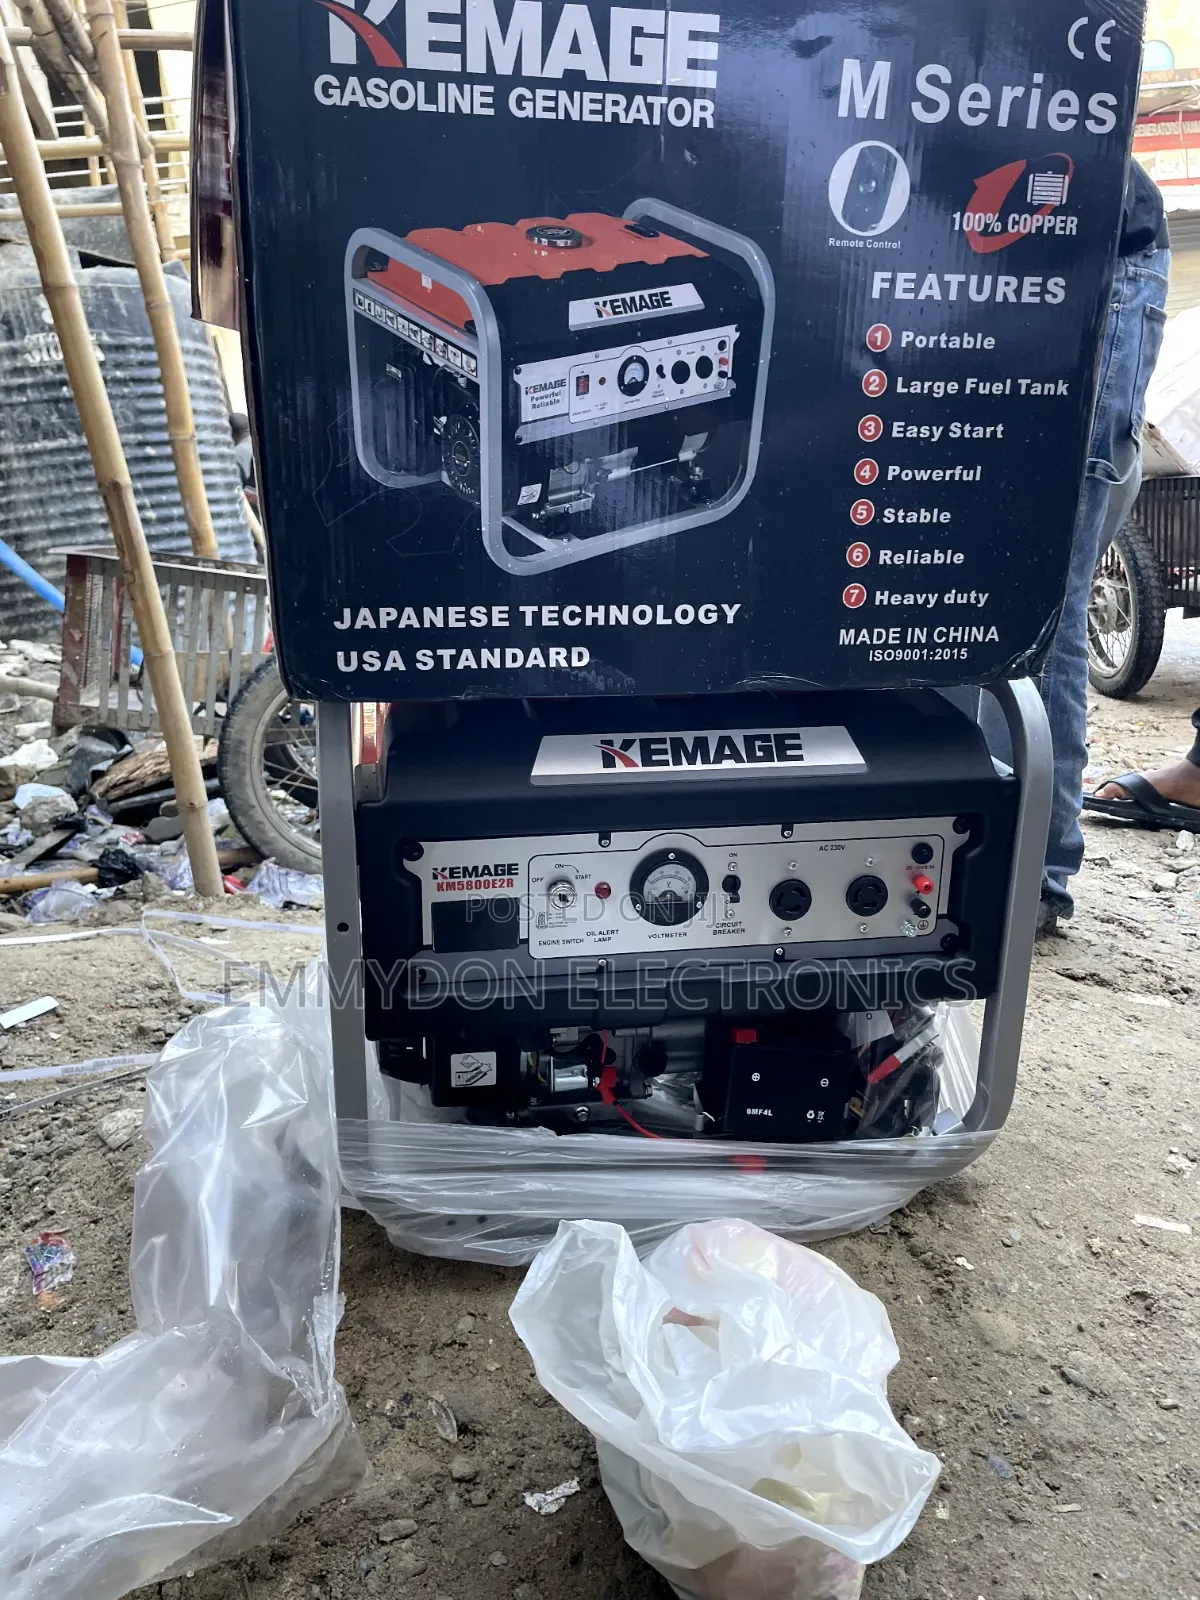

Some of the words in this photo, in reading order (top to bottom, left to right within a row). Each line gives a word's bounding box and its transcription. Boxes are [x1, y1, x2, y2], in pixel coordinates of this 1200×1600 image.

[313, 0, 720, 88] KEMAGE
[1068, 17, 1115, 62] CE
[314, 74, 495, 115] GASOLINE
[508, 87, 715, 128] GENERATOR
[838, 59, 891, 120] M
[911, 64, 1118, 134] Series
[953, 212, 1002, 233] 100%
[1007, 213, 1078, 235] COPPER
[829, 238, 864, 248] Remote
[866, 239, 901, 249] Control
[872, 271, 1066, 304] FEATURES
[593, 290, 673, 318] KEMAGE
[874, 331, 882, 345] 1
[901, 331, 996, 349] Portable
[525, 378, 567, 395] KEMAGE
[868, 376, 880, 391] 2
[896, 377, 959, 397] Large
[965, 378, 1011, 394] Fuel
[1018, 379, 1069, 396] Tank
[530, 389, 562, 403] Powerful
[531, 397, 561, 410] Reliable
[864, 421, 876, 436] 3
[892, 421, 944, 441] Easy
[949, 421, 1004, 439] Start
[860, 465, 871, 479] 4
[887, 465, 982, 481] Powerful
[856, 506, 867, 519] 5
[882, 508, 951, 523] Stable
[852, 548, 863, 562] 6
[879, 549, 965, 564] Reliable
[850, 590, 859, 602] 7
[874, 590, 938, 608] Heavy
[943, 590, 990, 607] duty
[333, 605, 510, 630] JAPANESE
[519, 603, 742, 626] TECHNOLOGY
[839, 628, 901, 645] MADE
[906, 627, 927, 644] IN
[933, 626, 1000, 643] CHINA
[336, 649, 406, 673] USA
[415, 646, 590, 672] STANDARD
[869, 648, 968, 661] ISO9001:2015
[592, 732, 805, 769] KEMAGE
[432, 863, 519, 880] KEMAGE
[436, 878, 515, 892] KM5800E2R
[713, 928, 746, 936] BREAKER
[746, 1108, 773, 1117] 6MF4L
